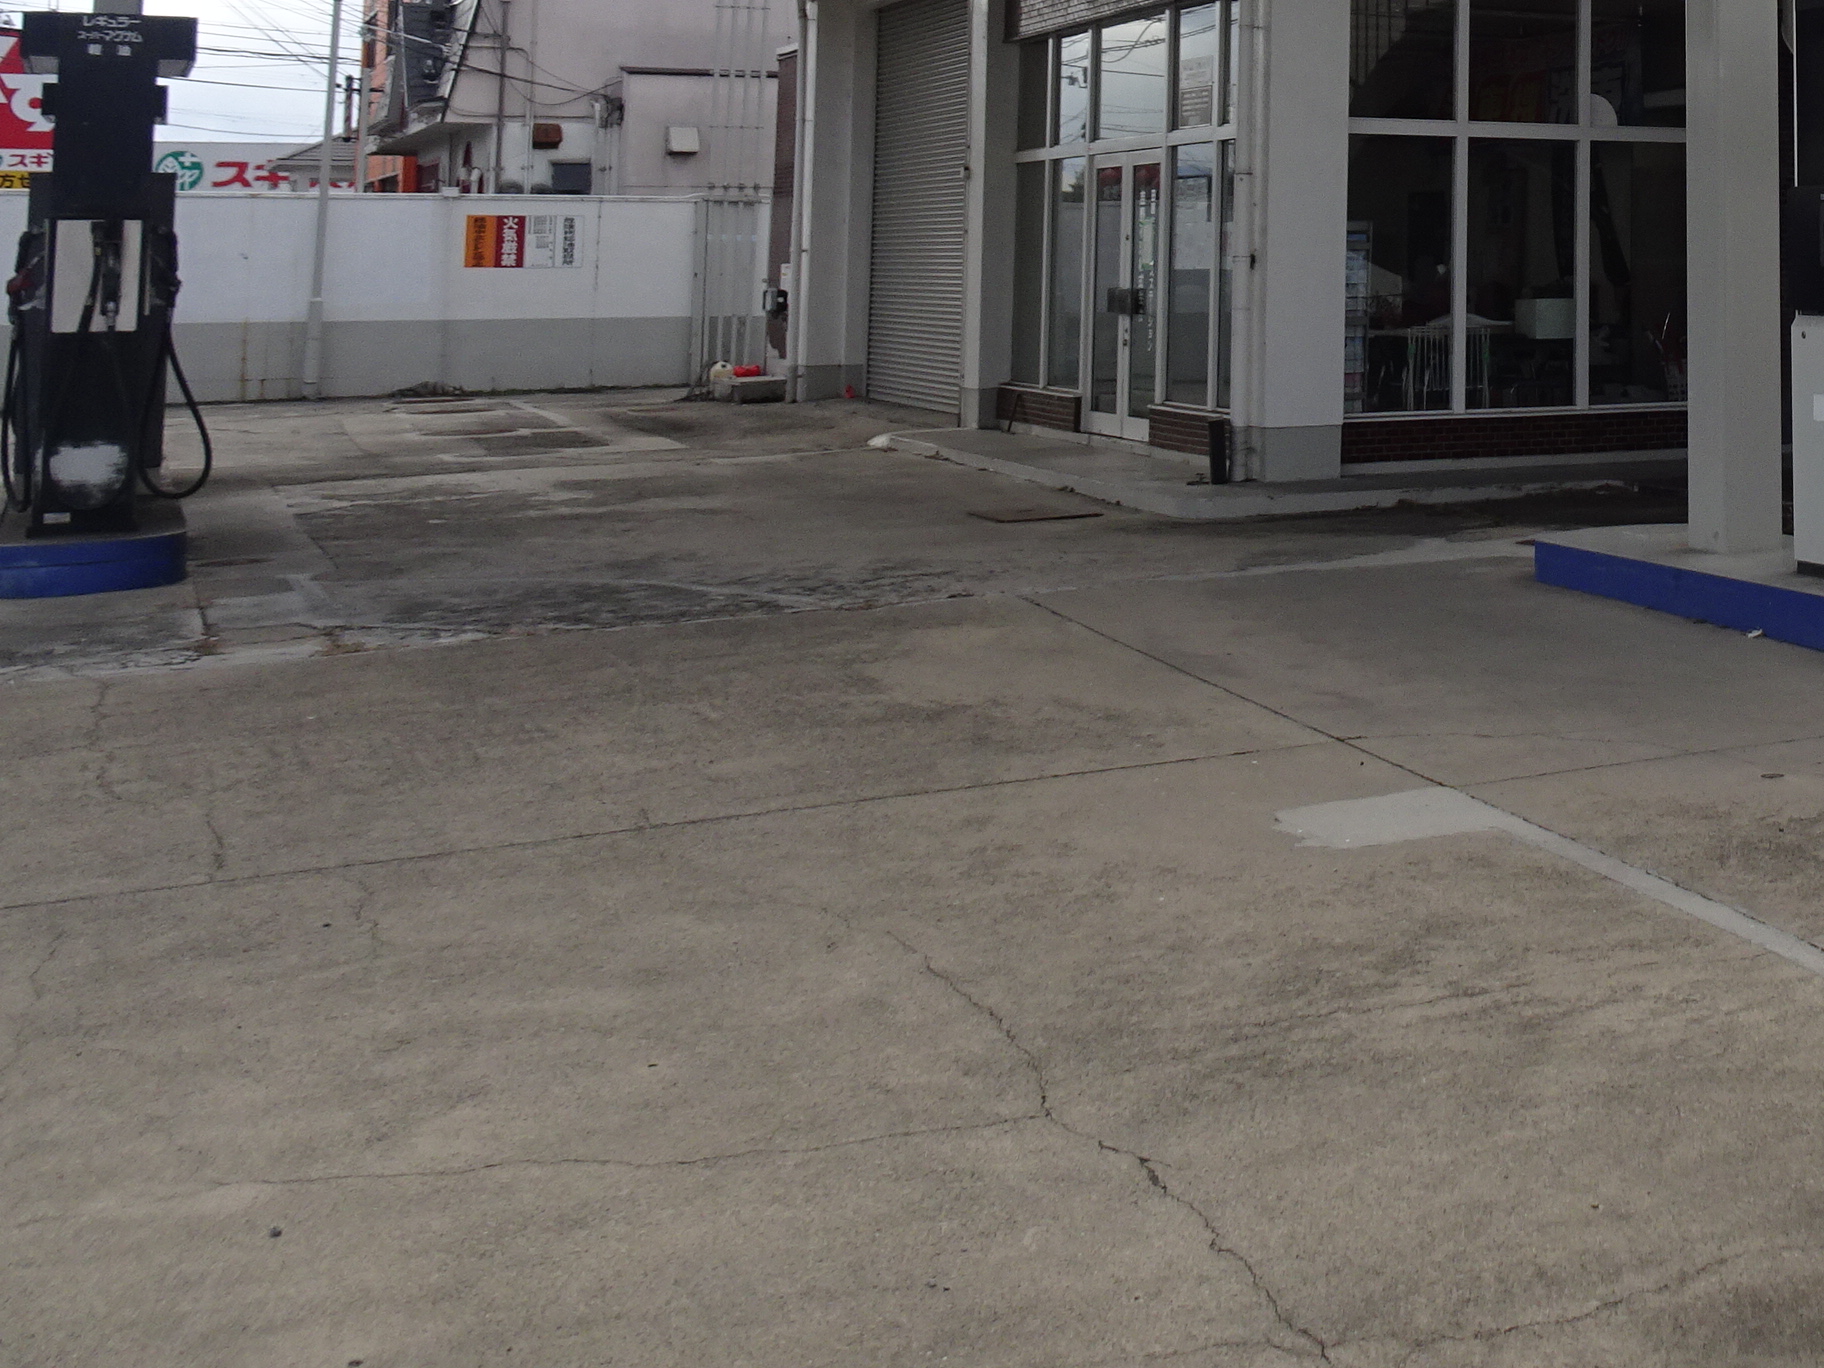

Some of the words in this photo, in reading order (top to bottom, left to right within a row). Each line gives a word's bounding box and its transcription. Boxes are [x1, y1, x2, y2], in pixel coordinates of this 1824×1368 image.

[82, 15, 142, 28] レギュラー
[500, 216, 519, 267] 火気厳禁
